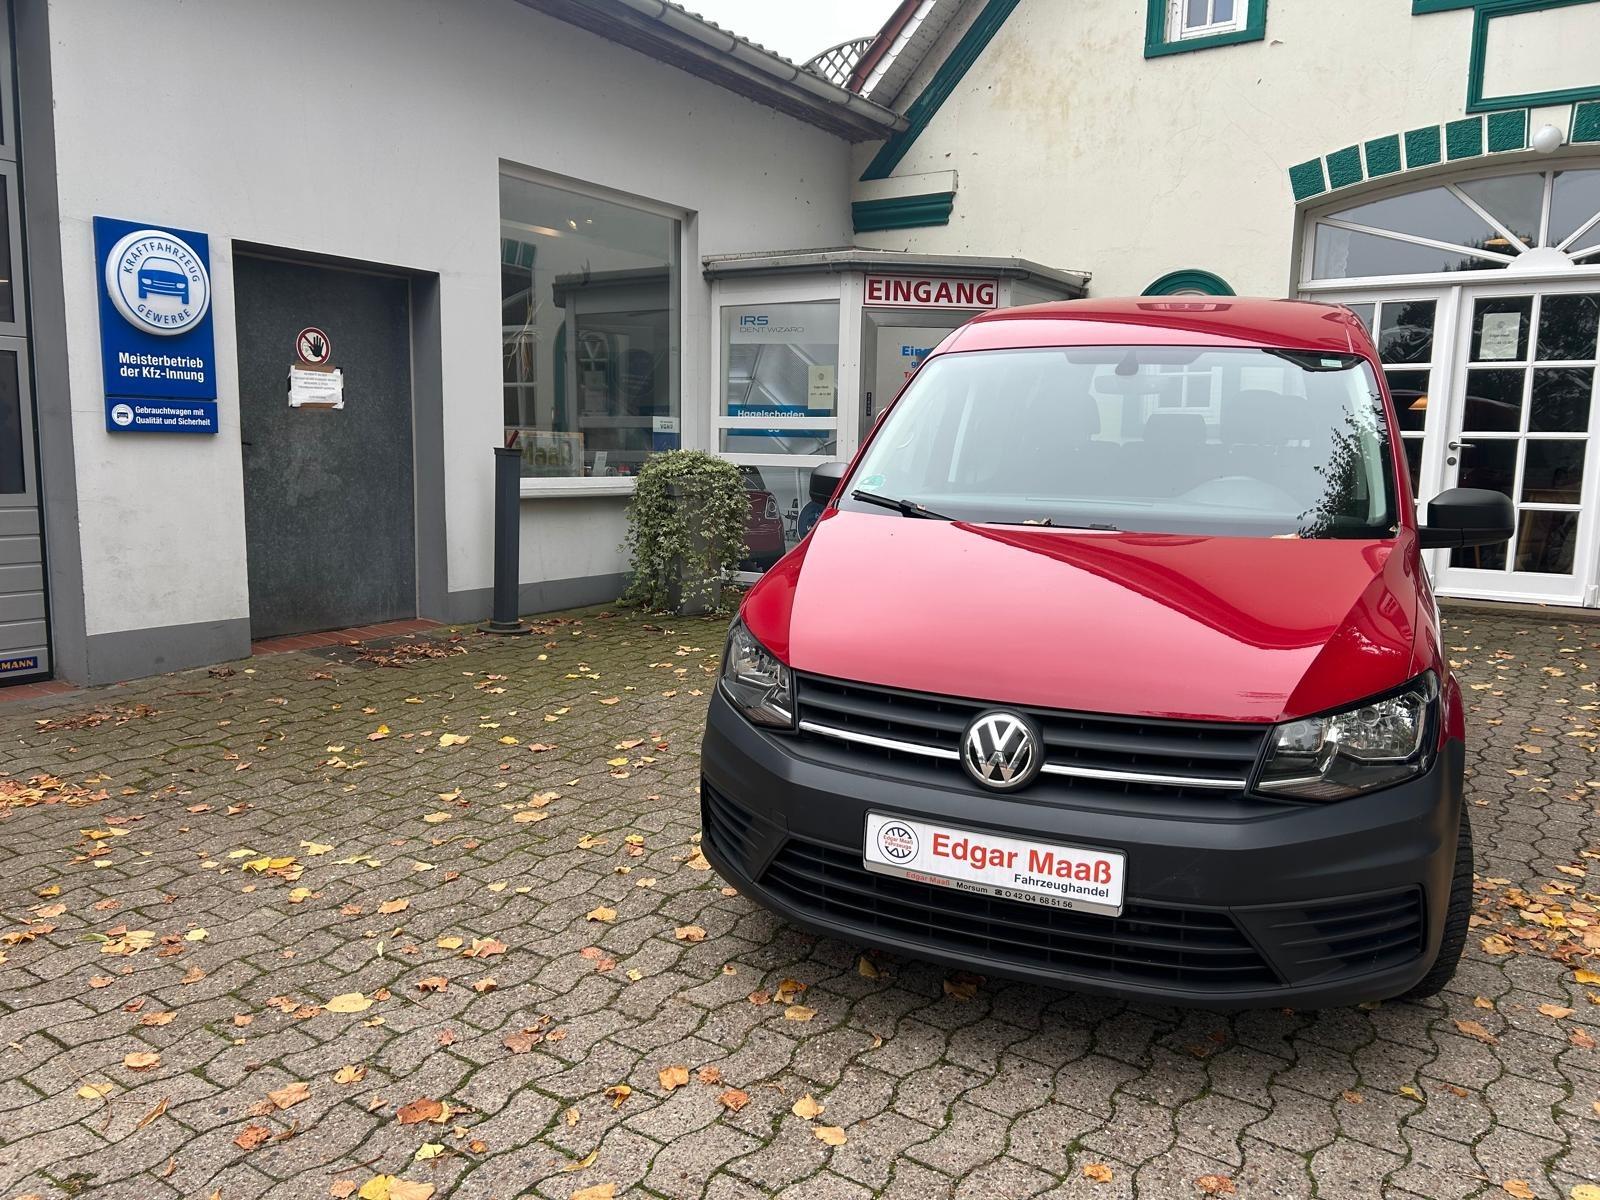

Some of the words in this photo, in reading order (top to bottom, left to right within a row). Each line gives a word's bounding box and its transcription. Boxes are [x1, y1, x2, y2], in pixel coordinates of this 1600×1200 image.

[123, 242, 200, 282] KRAFTFAHRZEUG
[868, 279, 994, 305] EINGANG
[137, 304, 191, 324] GEWERBE
[740, 315, 769, 326] IRS
[118, 351, 204, 369] Meisterbetrieb
[120, 365, 140, 377] der
[142, 366, 204, 383] Kfz-Innung
[135, 406, 192, 416] Gebrauchtwagen
[193, 408, 204, 416] mit
[135, 416, 163, 424] Qualität
[163, 417, 177, 425] und
[178, 417, 211, 426] Sicherheit
[0, 659, 34, 670] MANN
[932, 833, 1018, 870] Edgar
[1028, 849, 1112, 884] Maaß
[906, 871, 928, 881] Edgar
[956, 881, 988, 893] Morsum
[1013, 892, 1023, 900] 42
[1039, 896, 1050, 905] 68
[1051, 898, 1060, 906] 51
[1062, 900, 1073, 909] 56
[1014, 873, 1109, 898] Fahrzeughandel
